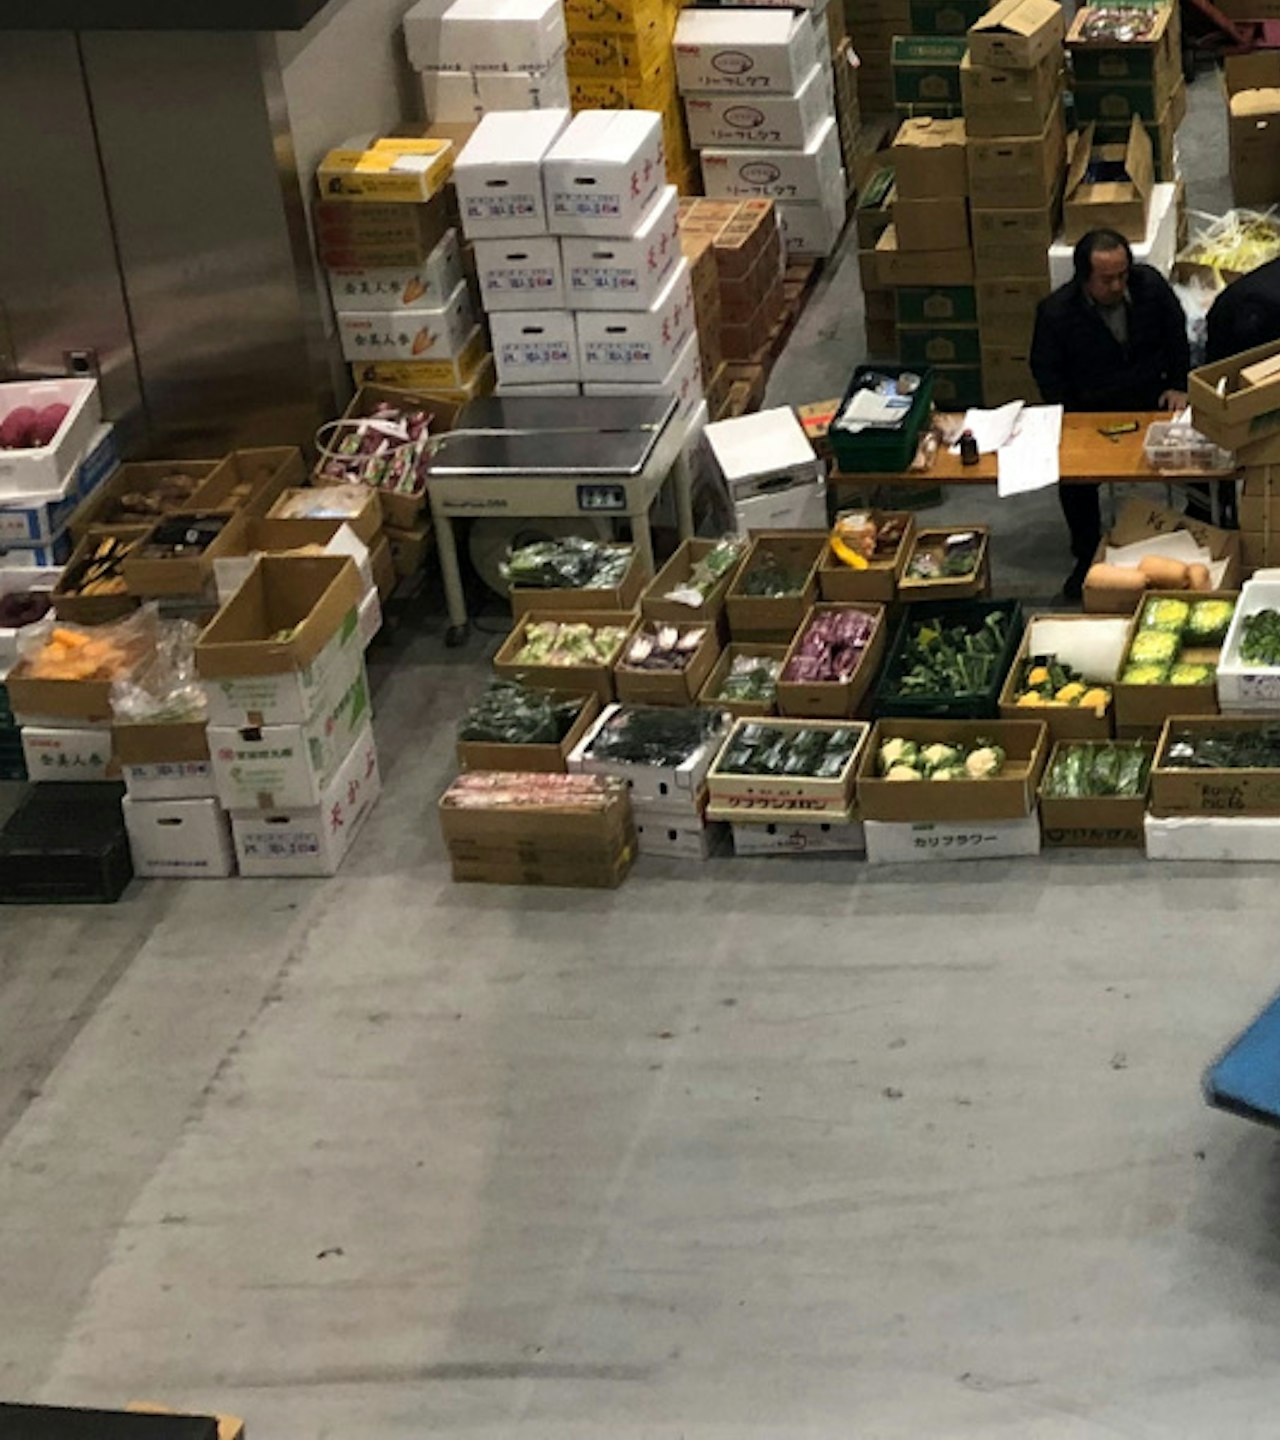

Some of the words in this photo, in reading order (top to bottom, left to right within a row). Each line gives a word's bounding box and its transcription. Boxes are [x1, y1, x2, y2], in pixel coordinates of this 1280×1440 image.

[913, 833, 999, 848] カリフラワー
